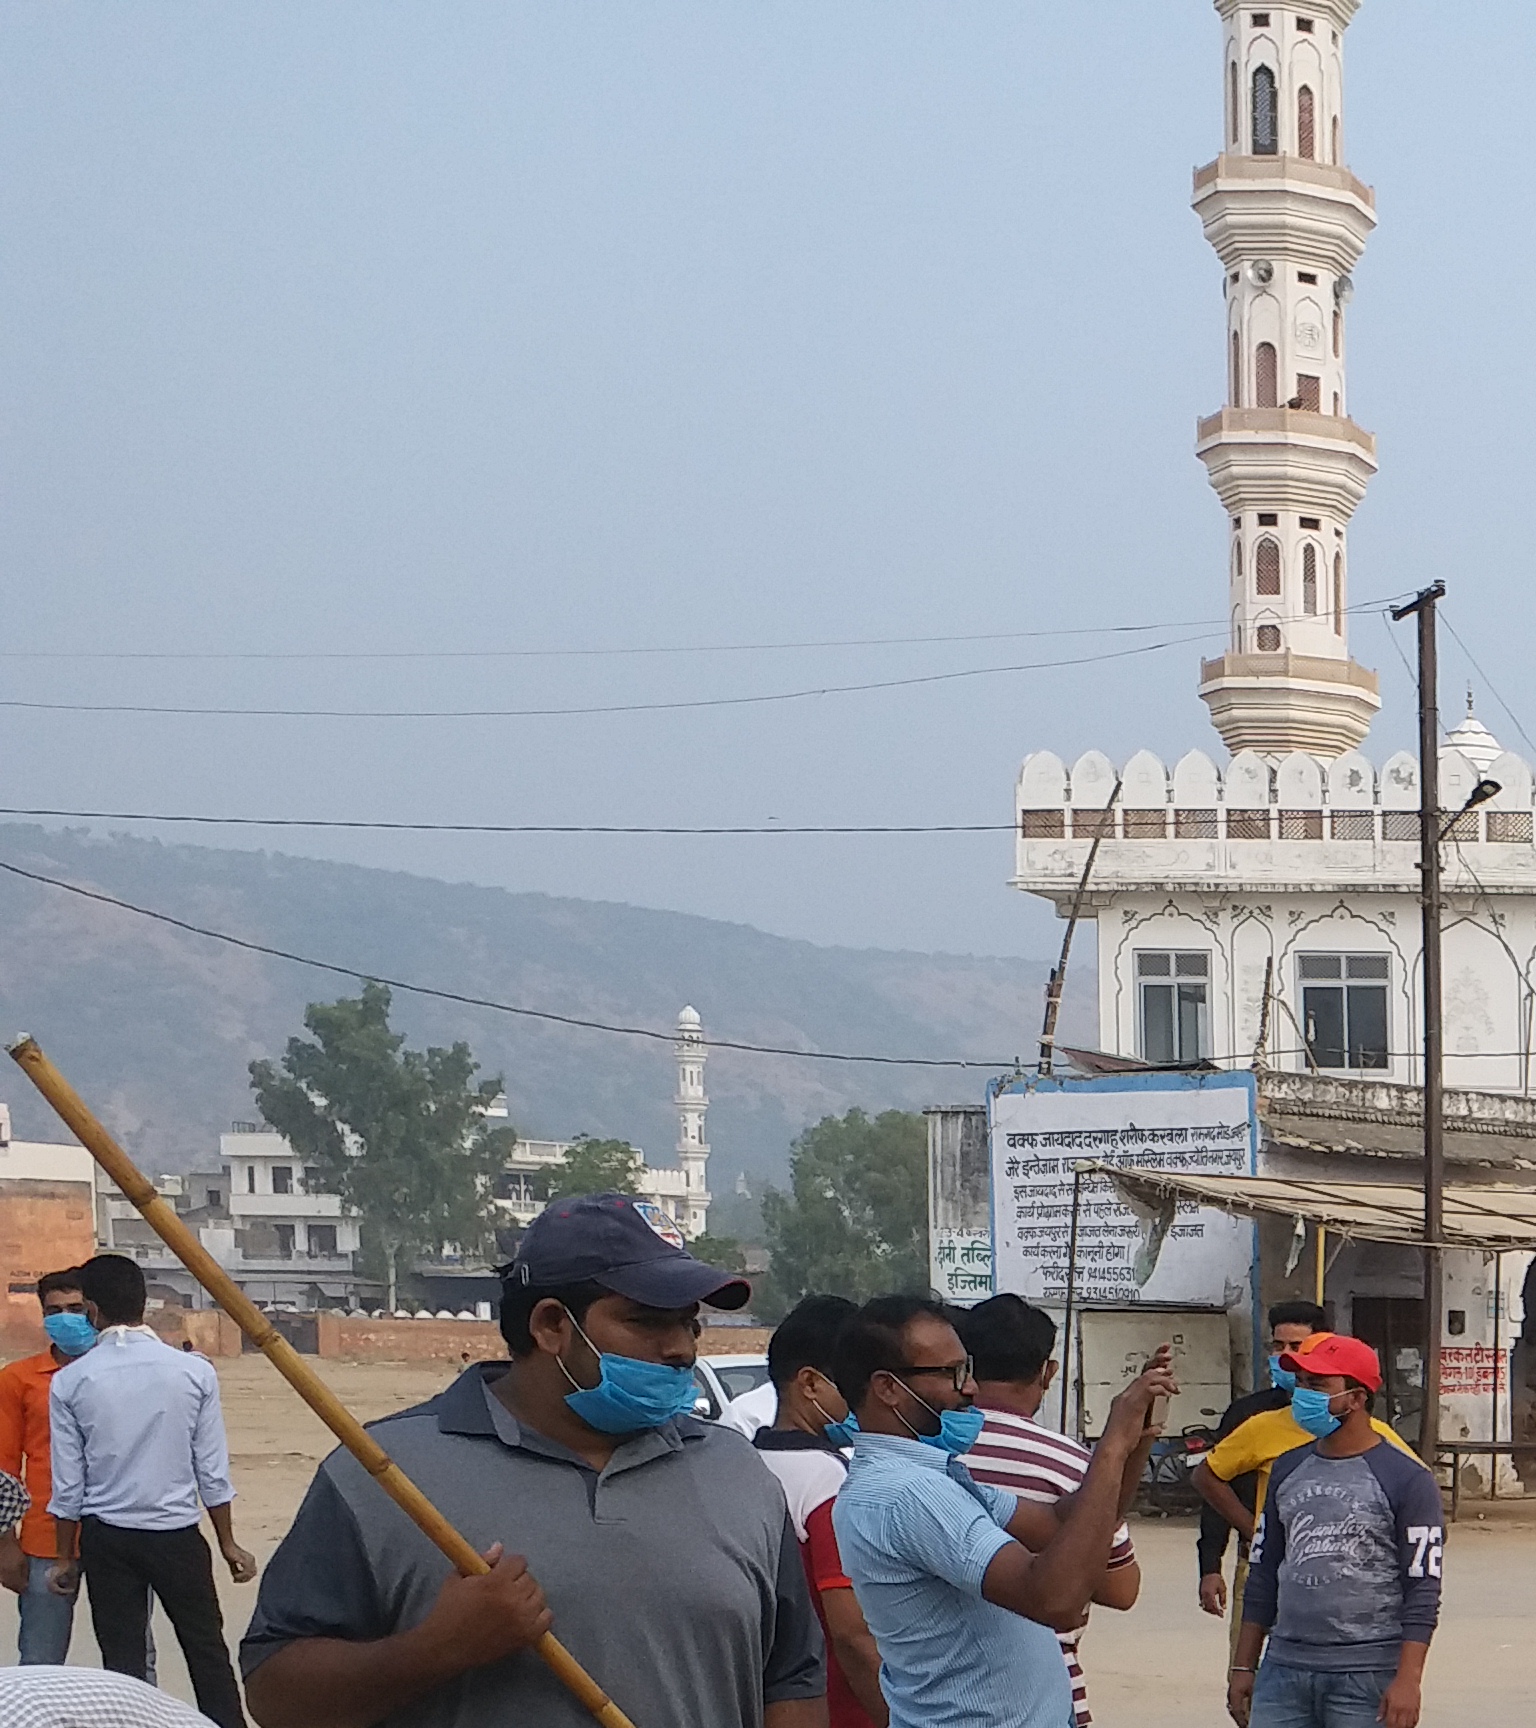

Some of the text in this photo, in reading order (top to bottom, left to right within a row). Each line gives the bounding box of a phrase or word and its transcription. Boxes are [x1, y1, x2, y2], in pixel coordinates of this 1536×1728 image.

[1006, 1132, 1039, 1149] वक्फ
[1039, 1131, 1082, 1149] जायदाद
[1082, 1129, 1118, 1149] दरगाह
[1407, 1526, 1442, 1579] 72
